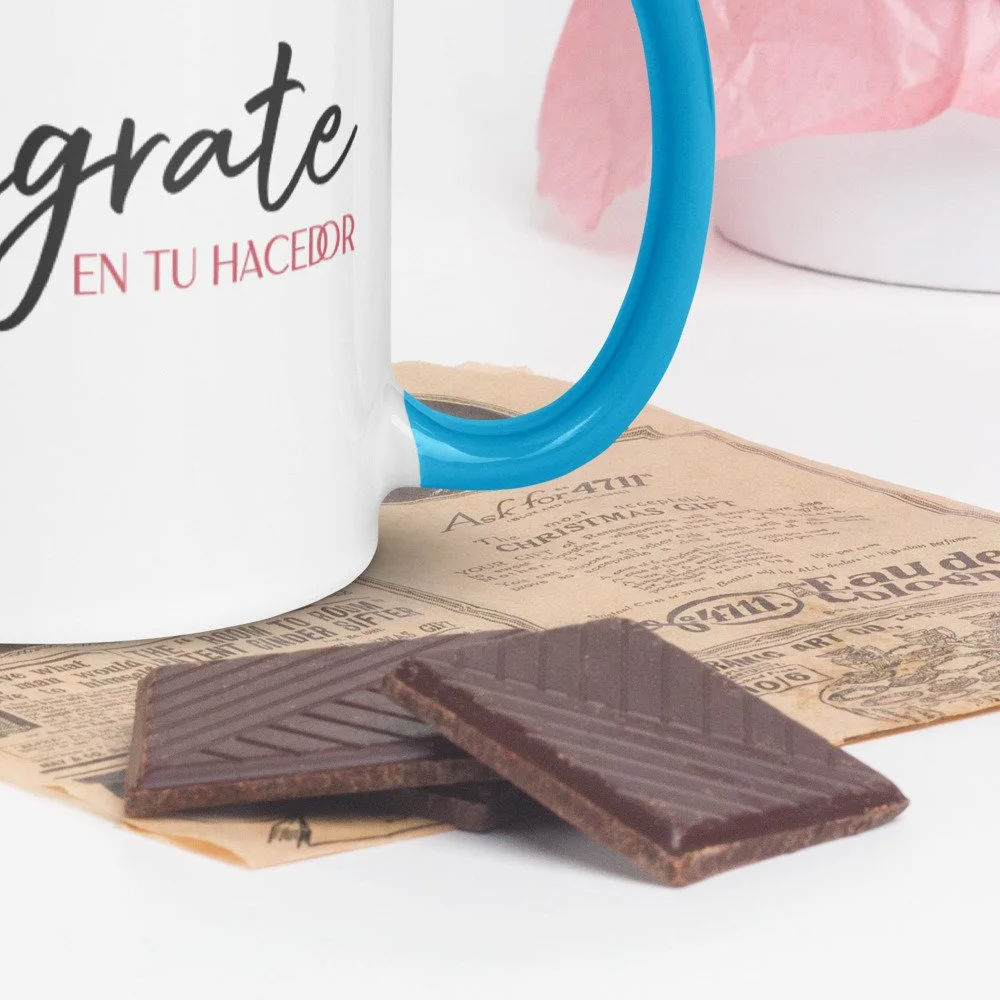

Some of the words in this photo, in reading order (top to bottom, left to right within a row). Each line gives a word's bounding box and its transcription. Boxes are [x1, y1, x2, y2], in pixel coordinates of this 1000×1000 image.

[73, 252, 127, 295] EN
[143, 247, 197, 292] TU
[211, 213, 355, 286] HACEDOR
[441, 498, 516, 533] Ask
[519, 489, 568, 510] for
[472, 534, 521, 546] The
[543, 510, 590, 528] most
[613, 495, 719, 511] acceptable
[495, 507, 664, 552] CHRISTMAS
[673, 499, 737, 512] GIFT
[801, 560, 934, 593] Eau
[939, 550, 1000, 571] de
[123, 644, 182, 659] THE
[265, 616, 311, 631] TO
[245, 625, 338, 651] CINDER
[333, 606, 424, 632] SIFTER
[790, 632, 844, 651] ART
[14, 675, 64, 689] man
[71, 659, 144, 679] would
[30, 658, 91, 676] what
[38, 687, 67, 695] to
